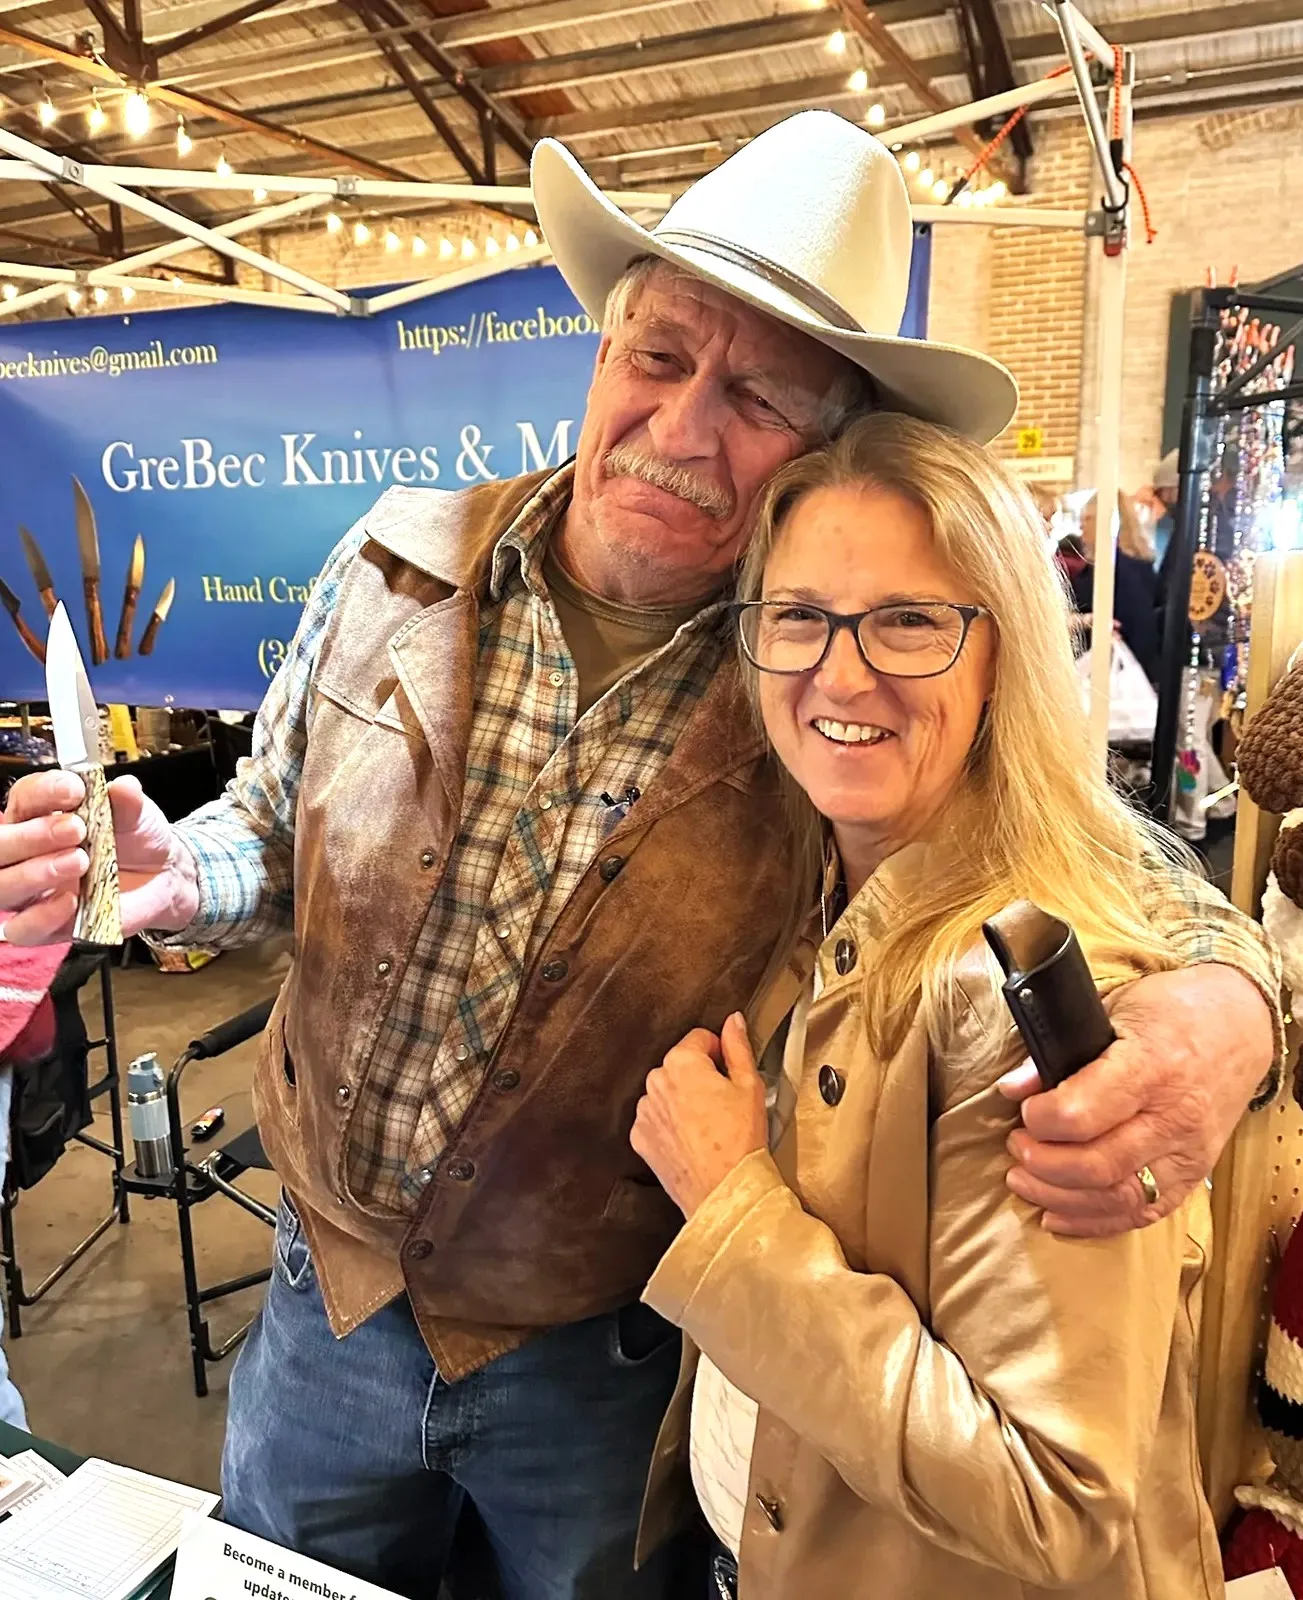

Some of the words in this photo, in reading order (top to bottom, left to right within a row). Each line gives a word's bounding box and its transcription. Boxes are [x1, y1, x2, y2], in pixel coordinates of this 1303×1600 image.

[101, 437, 266, 492] GreBec
[280, 430, 441, 486] Knives
[455, 424, 500, 481] &
[201, 575, 264, 603] Hand
[257, 638, 294, 680] (3
[223, 1542, 275, 1575] Become
[277, 1568, 286, 1580] a
[289, 1572, 347, 1600] member
[244, 1579, 295, 1600] updat
